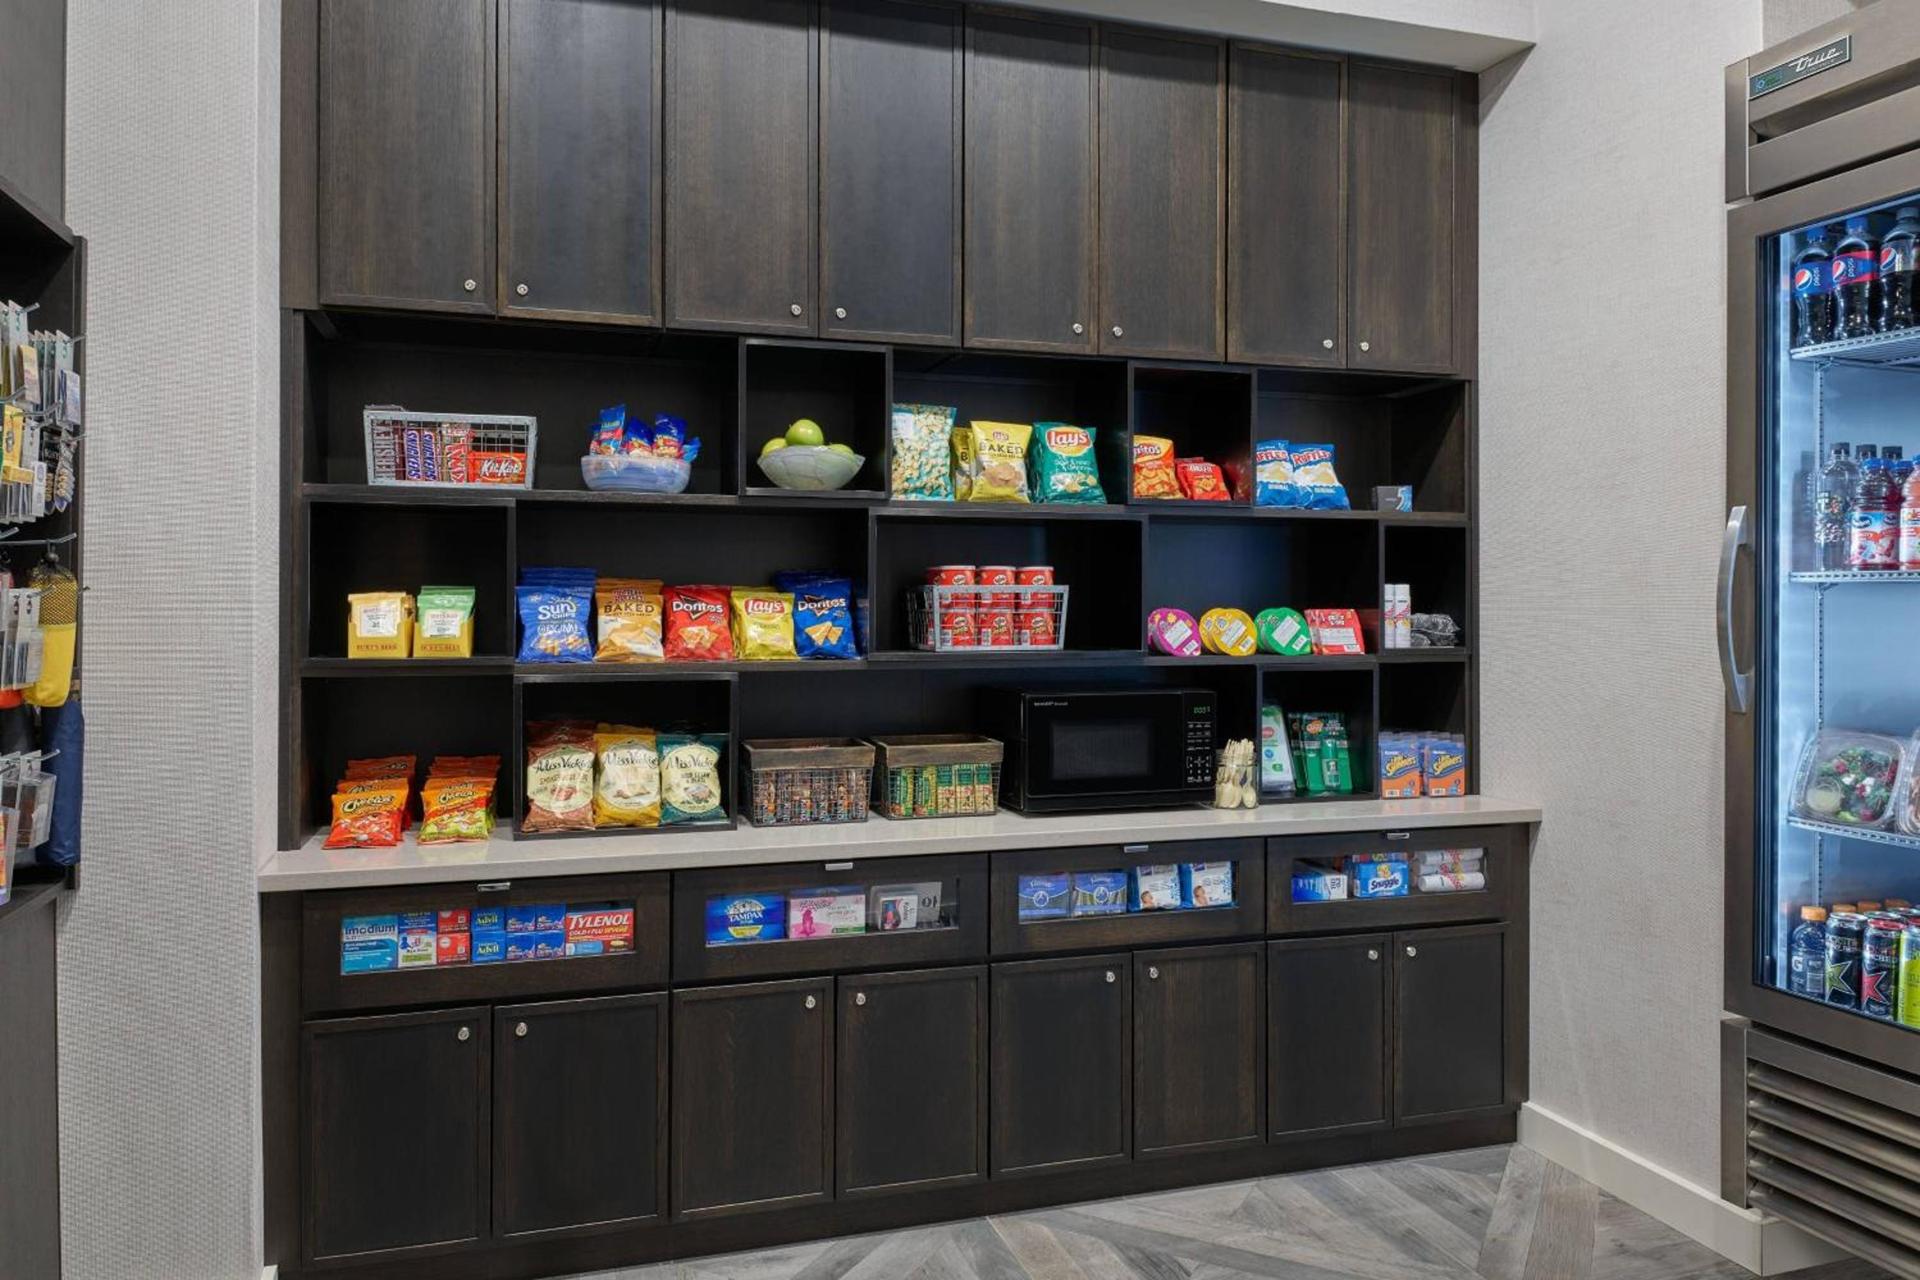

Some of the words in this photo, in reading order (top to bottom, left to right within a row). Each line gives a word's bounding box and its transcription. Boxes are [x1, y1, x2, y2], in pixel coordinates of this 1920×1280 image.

[978, 443, 1024, 455] BAKED
[603, 602, 655, 614] BAKED
[672, 602, 723, 613] Doritos
[797, 598, 846, 612] Doritos
[1371, 877, 1399, 890] Snuggle
[569, 914, 631, 931] TYLENOL
